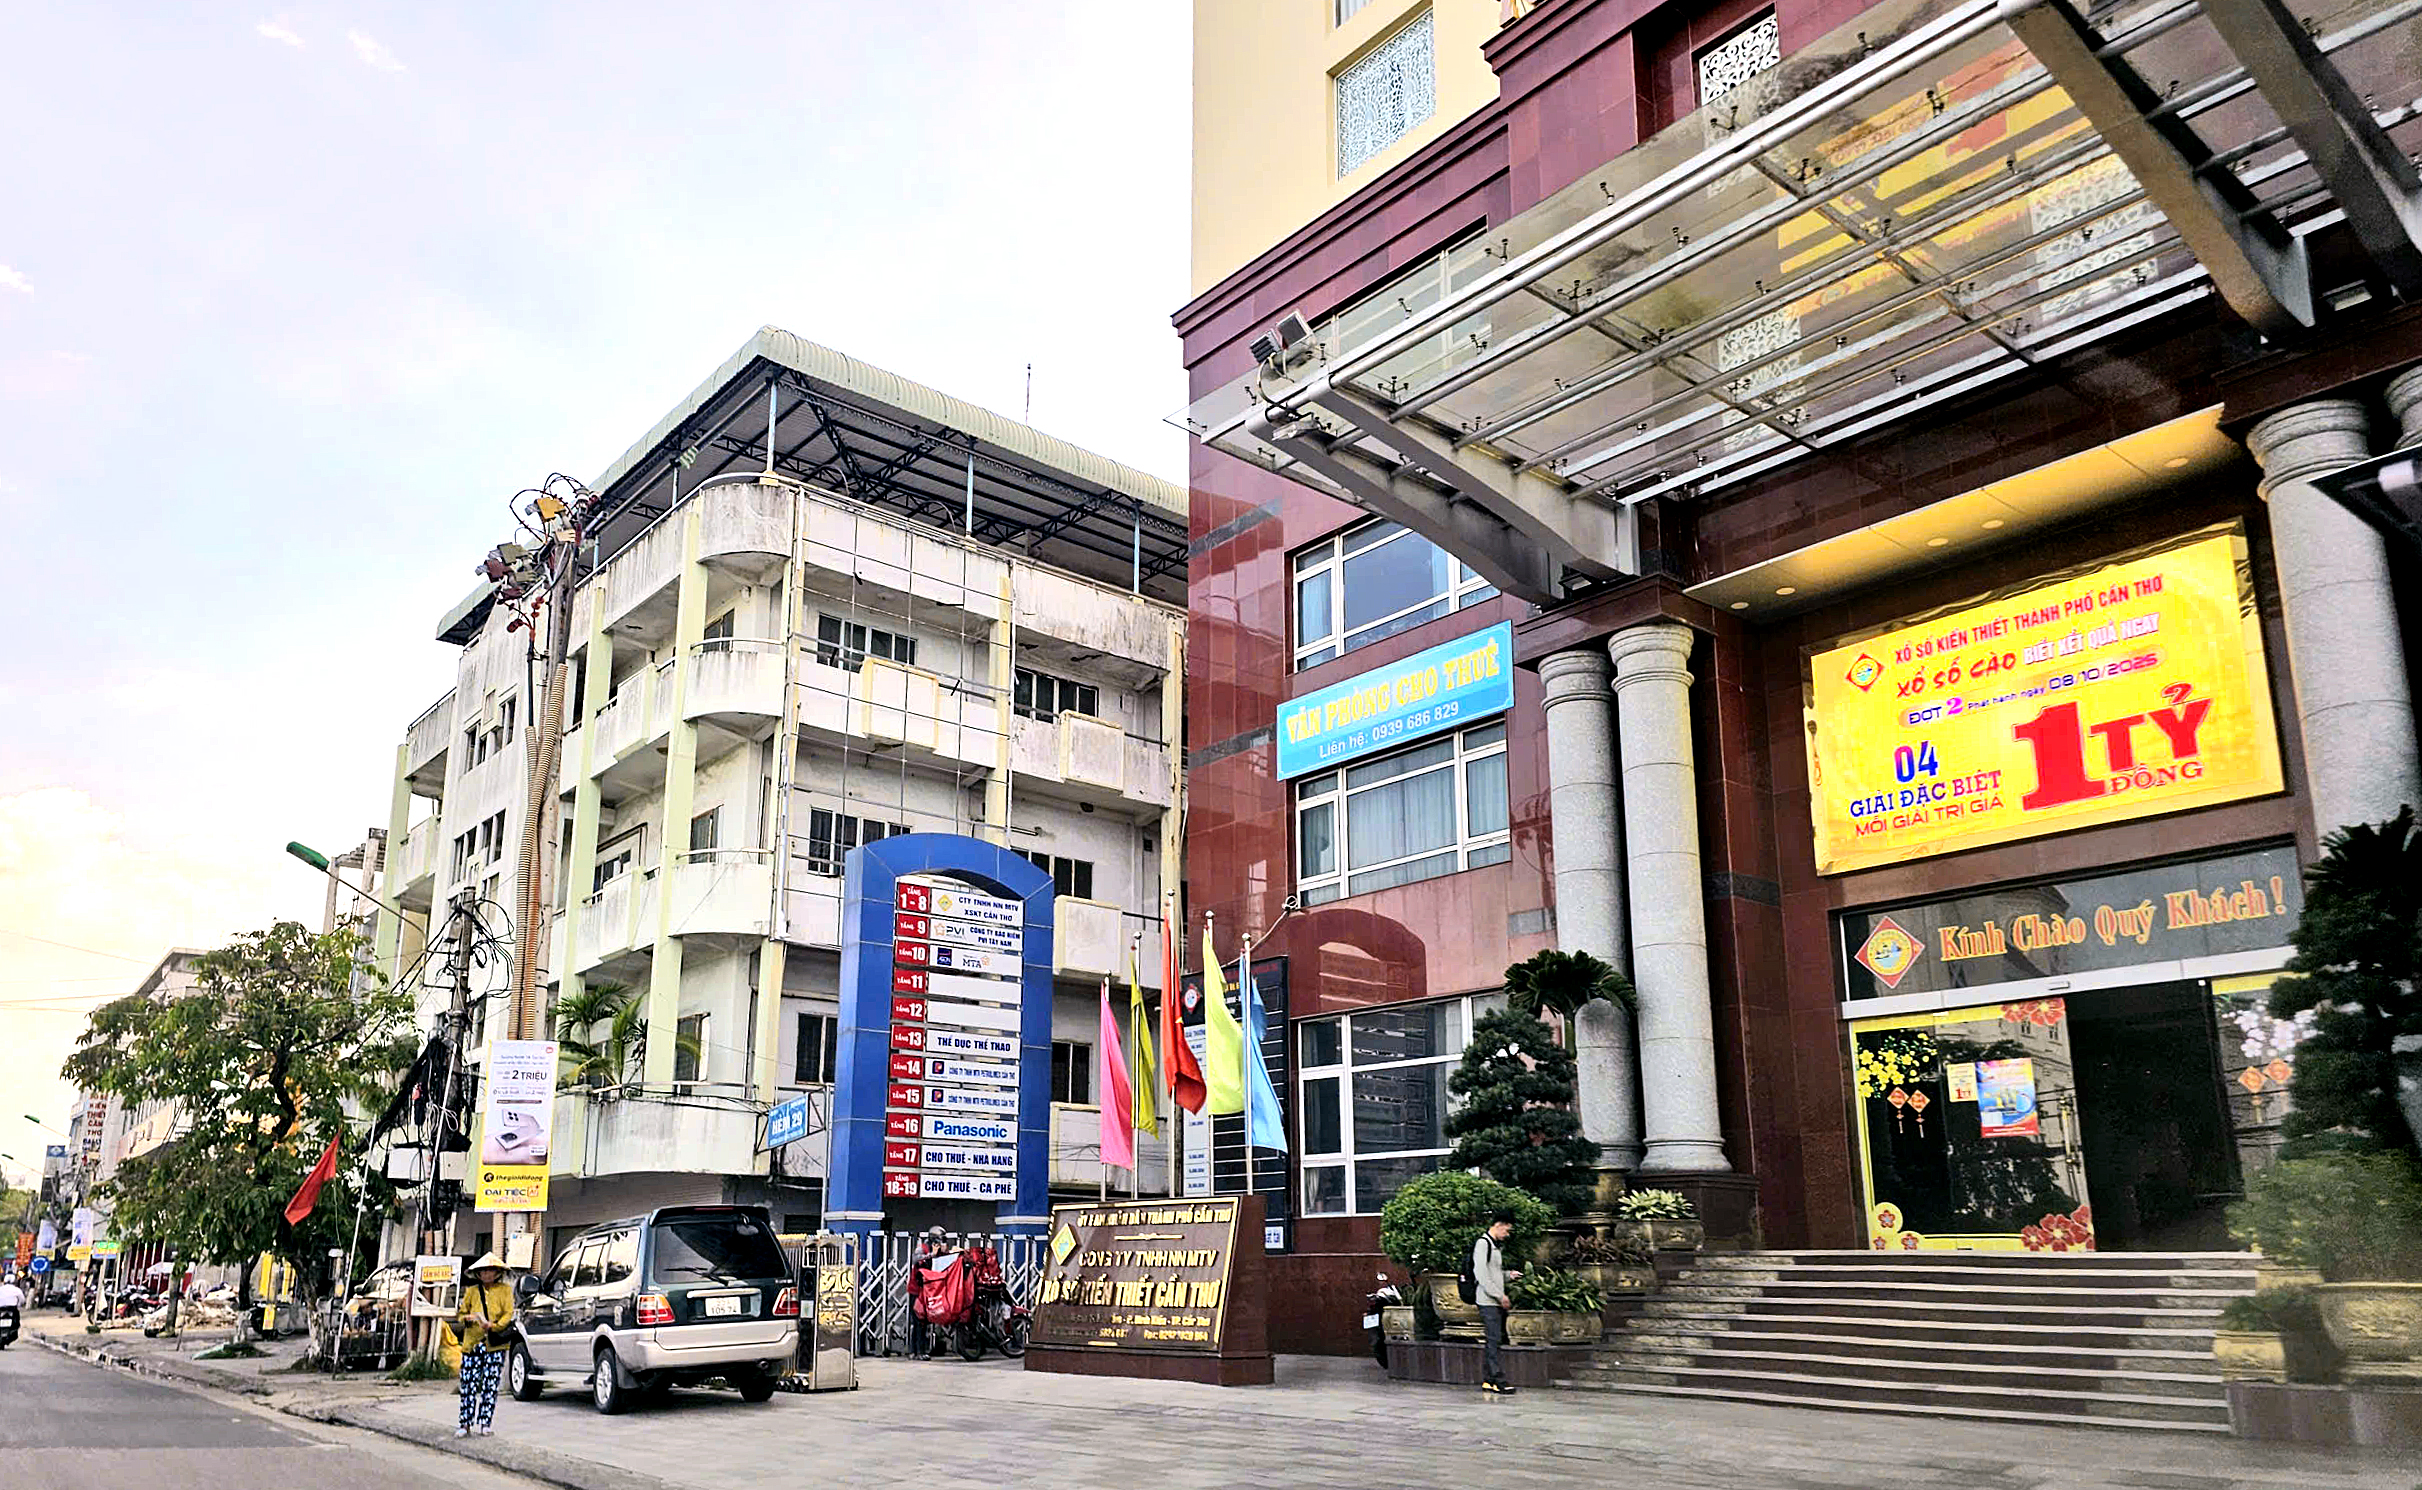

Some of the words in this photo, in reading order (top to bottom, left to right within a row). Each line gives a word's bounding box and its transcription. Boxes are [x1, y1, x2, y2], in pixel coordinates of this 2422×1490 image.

[1937, 629, 1968, 653] KIẾN
[1972, 617, 2009, 644] THIẾT
[2064, 591, 2095, 619] PHỐ
[2133, 573, 2164, 599] THƠ
[1896, 665, 1926, 699] XỔ
[1933, 657, 1961, 689] SỐ
[1969, 651, 2016, 680] CÀO
[2023, 638, 2055, 665] BIẾT
[2059, 629, 2084, 656] KẾT
[2120, 612, 2160, 640] NGAY
[1287, 703, 1321, 743] VĂN
[1325, 681, 1391, 731] PHÒNG
[1396, 666, 1438, 705] CHO
[1443, 636, 1500, 690] THUÊ
[1946, 697, 1963, 716] 2
[2049, 652, 2158, 690] 08/10/2025
[1319, 740, 1345, 759] Liên
[1348, 731, 1369, 751] hệ:
[1372, 720, 1403, 741] 0939
[1407, 709, 1430, 729] 686
[1434, 700, 1459, 723] 829
[2013, 701, 2106, 812] 1
[2089, 682, 2214, 773] TỶ
[1894, 740, 1938, 784] 04
[1850, 789, 1894, 818] GIẢI
[1899, 782, 1946, 809] ĐẶC
[1952, 769, 2002, 798] BIỆT
[1969, 795, 2004, 815] GIÁ
[958, 896, 971, 905] CTY
[974, 897, 991, 908] TNHH
[964, 909, 982, 918] XSKT
[917, 920, 926, 934] 9
[946, 925, 965, 936] PVI
[1938, 920, 2007, 961] Kính
[2012, 913, 2086, 952] Chào
[2094, 899, 2158, 946] Quý
[912, 947, 925, 961] 10
[963, 958, 982, 968] MTA
[911, 974, 923, 989] 11
[909, 1003, 923, 1017] 12
[908, 1031, 922, 1046] 13
[991, 1042, 1011, 1052] THAO
[512, 1070, 519, 1080] 2
[907, 1060, 920, 1075] 14
[905, 1089, 920, 1103] 15
[792, 1111, 803, 1128] 29
[904, 1118, 918, 1133] 16
[933, 1120, 1008, 1138] Panasonic
[903, 1148, 917, 1163] 17
[925, 1151, 943, 1163] CHO
[885, 1181, 917, 1195] 18-19
[924, 1180, 944, 1192] CHO
[1115, 1250, 1134, 1267] TY
[1115, 1274, 1155, 1307] THIẾT
[1155, 1273, 1188, 1307] CẦN
[1189, 1279, 1221, 1308] THƠ
